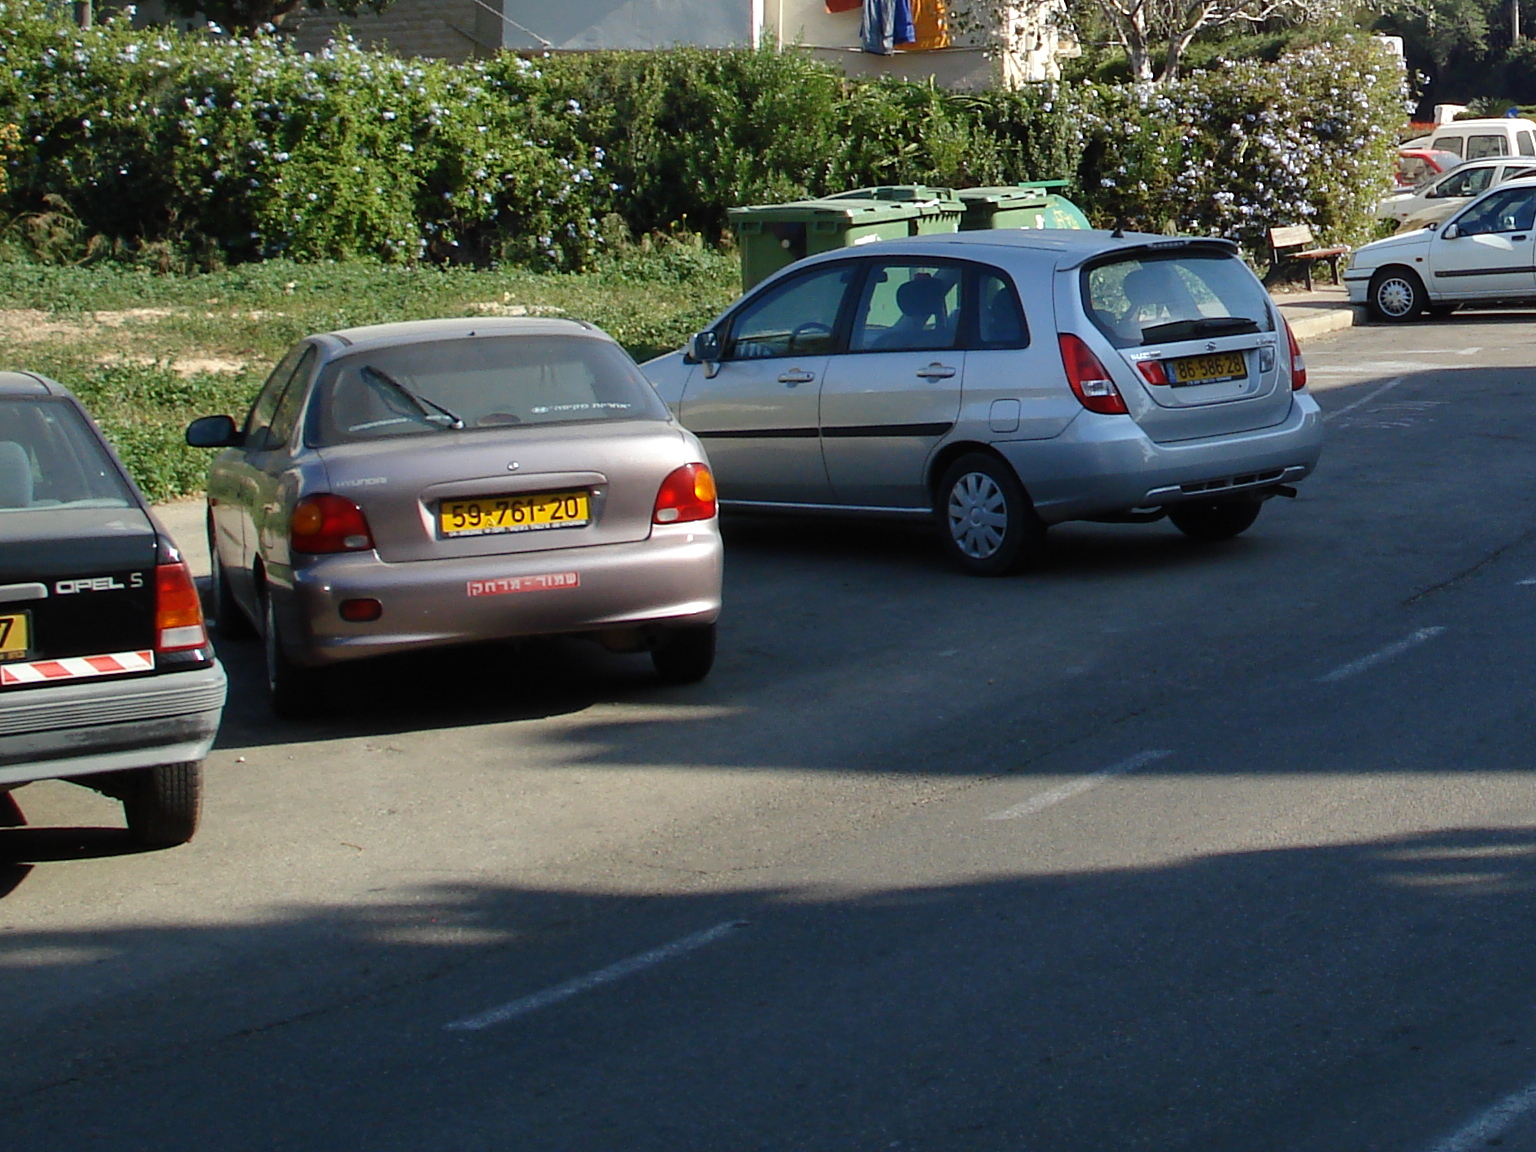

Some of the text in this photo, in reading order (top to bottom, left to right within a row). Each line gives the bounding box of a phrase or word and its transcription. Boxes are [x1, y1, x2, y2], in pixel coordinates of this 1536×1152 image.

[1178, 355, 1241, 379] 86-586-28
[452, 496, 579, 528] 59-761-20
[55, 572, 143, 594] OPEL S
[471, 578, 520, 596] מרחק
[536, 572, 577, 587] שמור
